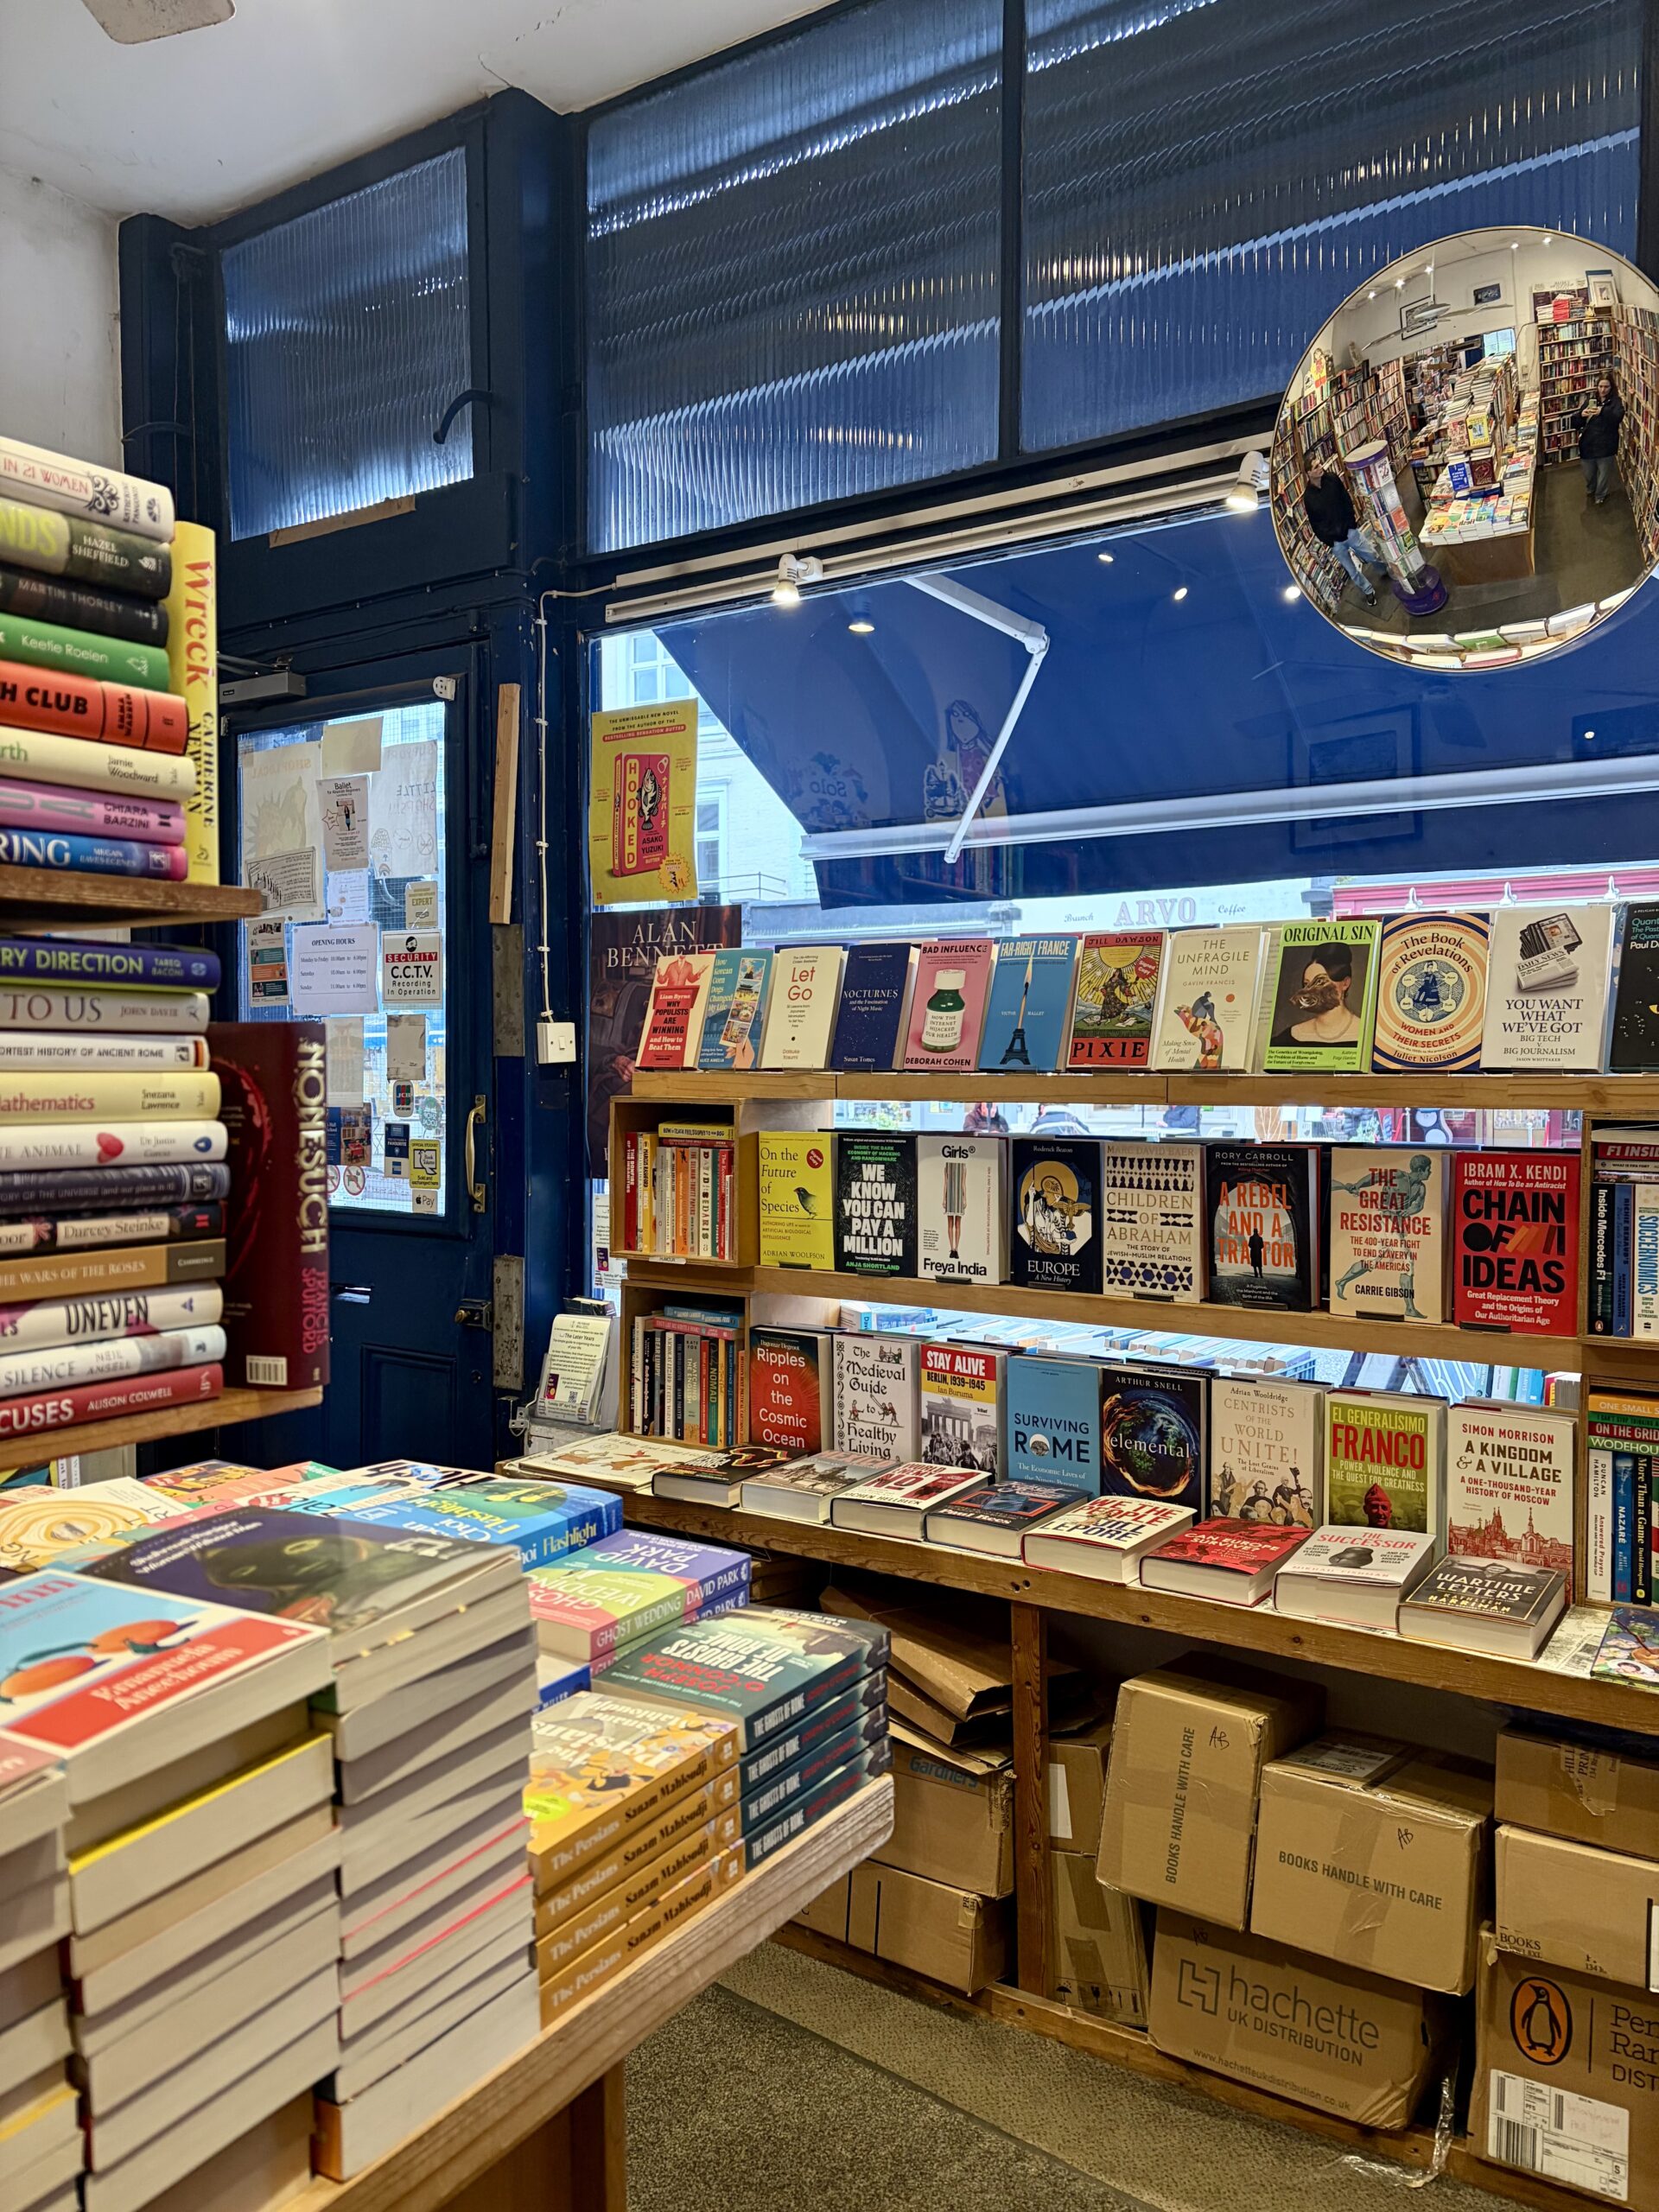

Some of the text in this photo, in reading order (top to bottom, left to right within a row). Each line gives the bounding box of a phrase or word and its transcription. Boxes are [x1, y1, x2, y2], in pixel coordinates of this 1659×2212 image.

[3, 456, 88, 495] IN 21 WOMEN
[185, 560, 213, 690] Wreck
[26, 688, 89, 715] CLUB
[619, 715, 649, 723] UNMISSABLE
[108, 766, 159, 785] Woodward
[104, 801, 149, 817] CHIARA
[626, 762, 638, 863] HOOKED
[104, 815, 149, 830] BARZINI
[641, 844, 664, 855] YUZUKI
[642, 835, 664, 845] ASAKO
[411, 897, 433, 906] EXPERT
[1114, 897, 1246, 926] ARVO Coffee
[632, 921, 697, 944] ALAN
[1088, 935, 1160, 946] JILL DAWSON
[1284, 925, 1376, 943] ORIGINAL SIN
[1401, 931, 1466, 950] The Book
[311, 938, 355, 947] OPENING HOURS
[922, 945, 939, 955] BAD
[1000, 939, 1070, 957] FAR-RIGHT FRANCE
[1202, 939, 1226, 951] THE
[35, 950, 143, 976] DIRECTION
[387, 952, 436, 963] SECURITY
[1178, 951, 1250, 964] UNFRAGILE
[1401, 945, 1473, 974] Revelations
[391, 965, 433, 979] C.C.T.V.
[791, 966, 816, 983] Let
[1192, 964, 1229, 976] MIND
[392, 979, 431, 988] Recording
[397, 987, 435, 996] Operation
[788, 985, 813, 1002] Go
[842, 988, 899, 1000] NOCTURNES
[10, 995, 103, 1023] TO US
[654, 1007, 689, 1016] POPULISTS
[666, 1000, 681, 1008] WHY
[1505, 999, 1584, 1010] YOU WANT
[1520, 1011, 1566, 1021] WHAT
[652, 1026, 684, 1035] WINNING
[1550, 1022, 1583, 1033] GOT
[37, 1046, 164, 1058] HISTORY OF ANCIENT ROME
[1072, 1041, 1146, 1059] PIXIE
[1392, 1050, 1458, 1063] Juliet Nicolson
[1520, 1047, 1576, 1056] JOURNALISM
[905, 1057, 971, 1066] DEBORAH COHEN
[297, 1037, 328, 1253] NONESUCH
[760, 1147, 799, 1161] On the
[1215, 1151, 1294, 1161] RORY CARROLL
[760, 1164, 797, 1179] Future
[861, 1164, 885, 1182] WE
[1368, 1168, 1398, 1188] THE
[1464, 1162, 1567, 1182] IBRAM X. KENDI
[760, 1180, 772, 1195] of
[850, 1181, 897, 1201] KNOW
[422, 1196, 435, 1208] Pay
[760, 1199, 800, 1215] Species
[842, 1198, 906, 1220] YOU CAN
[1106, 1191, 1194, 1210] CHILDREN
[1358, 1190, 1408, 1211] GREAT
[1462, 1189, 1567, 1224] CHAIN
[1139, 1211, 1159, 1224] OF
[1340, 1211, 1432, 1236] RESISTANCE
[851, 1218, 895, 1238] PAY A
[1106, 1228, 1192, 1245] ABRAHAM
[1596, 1189, 1608, 1281] Inside Mercedes F1
[843, 1236, 904, 1257] MILLION
[1637, 1214, 1659, 1296] SOCCERNOMICS
[923, 1258, 988, 1277] Freya India
[1027, 1260, 1081, 1277] EUROPE
[1462, 1255, 1567, 1295] IDEAS
[1354, 1284, 1415, 1300] CARRIE GIBSON
[65, 1295, 149, 1335] UNEVEN
[757, 1347, 806, 1368] Ripples
[926, 1350, 986, 1377] STAY ALIVE
[4, 1361, 76, 1388] SILENCE
[772, 1372, 790, 1386] on
[846, 1360, 906, 1382] Medieval
[849, 1377, 888, 1396] Guide
[1115, 1376, 1183, 1392] ARTHUR SNELL
[87, 1386, 173, 1412] ALISON COLWELL
[771, 1390, 793, 1407] the
[1224, 1396, 1295, 1419] CENTRISTS
[759, 1408, 807, 1429] Cosmic
[1014, 1412, 1090, 1436] SURVIVING
[762, 1428, 805, 1449] Ocean
[846, 1426, 897, 1446] Healthy
[1461, 1423, 1555, 1445] SIMON MORRISON
[848, 1441, 892, 1461] Living
[1110, 1434, 1191, 1459] elemental
[1332, 1423, 1426, 1471] FRANCO
[1479, 1442, 1554, 1465] KINGDOM
[1491, 1461, 1563, 1484] VILLAGE
[543, 1523, 598, 1557] Flashlight
[1039, 1521, 1141, 1543] LEPORE
[1319, 1534, 1418, 1550] SUCCESSOR
[594, 1551, 691, 1575] DAVID
[1436, 1573, 1537, 1594] WARTIME
[1436, 1581, 1523, 1602] LETTERS
[596, 1596, 682, 1648] GHOST WEDDING
[1165, 1727, 1195, 1884] BOOKS HANDLE WITH CARE
[1279, 1851, 1443, 1910] BOOKS HANDLE WITH CARE
[1499, 1932, 1541, 1951] BOOKS
[1228, 1964, 1381, 2050] hachette
[1227, 2007, 1363, 2067] UK DISTRIBUTION
[1193, 2046, 1351, 2111] www.hachetteukdistribution.co.uk
